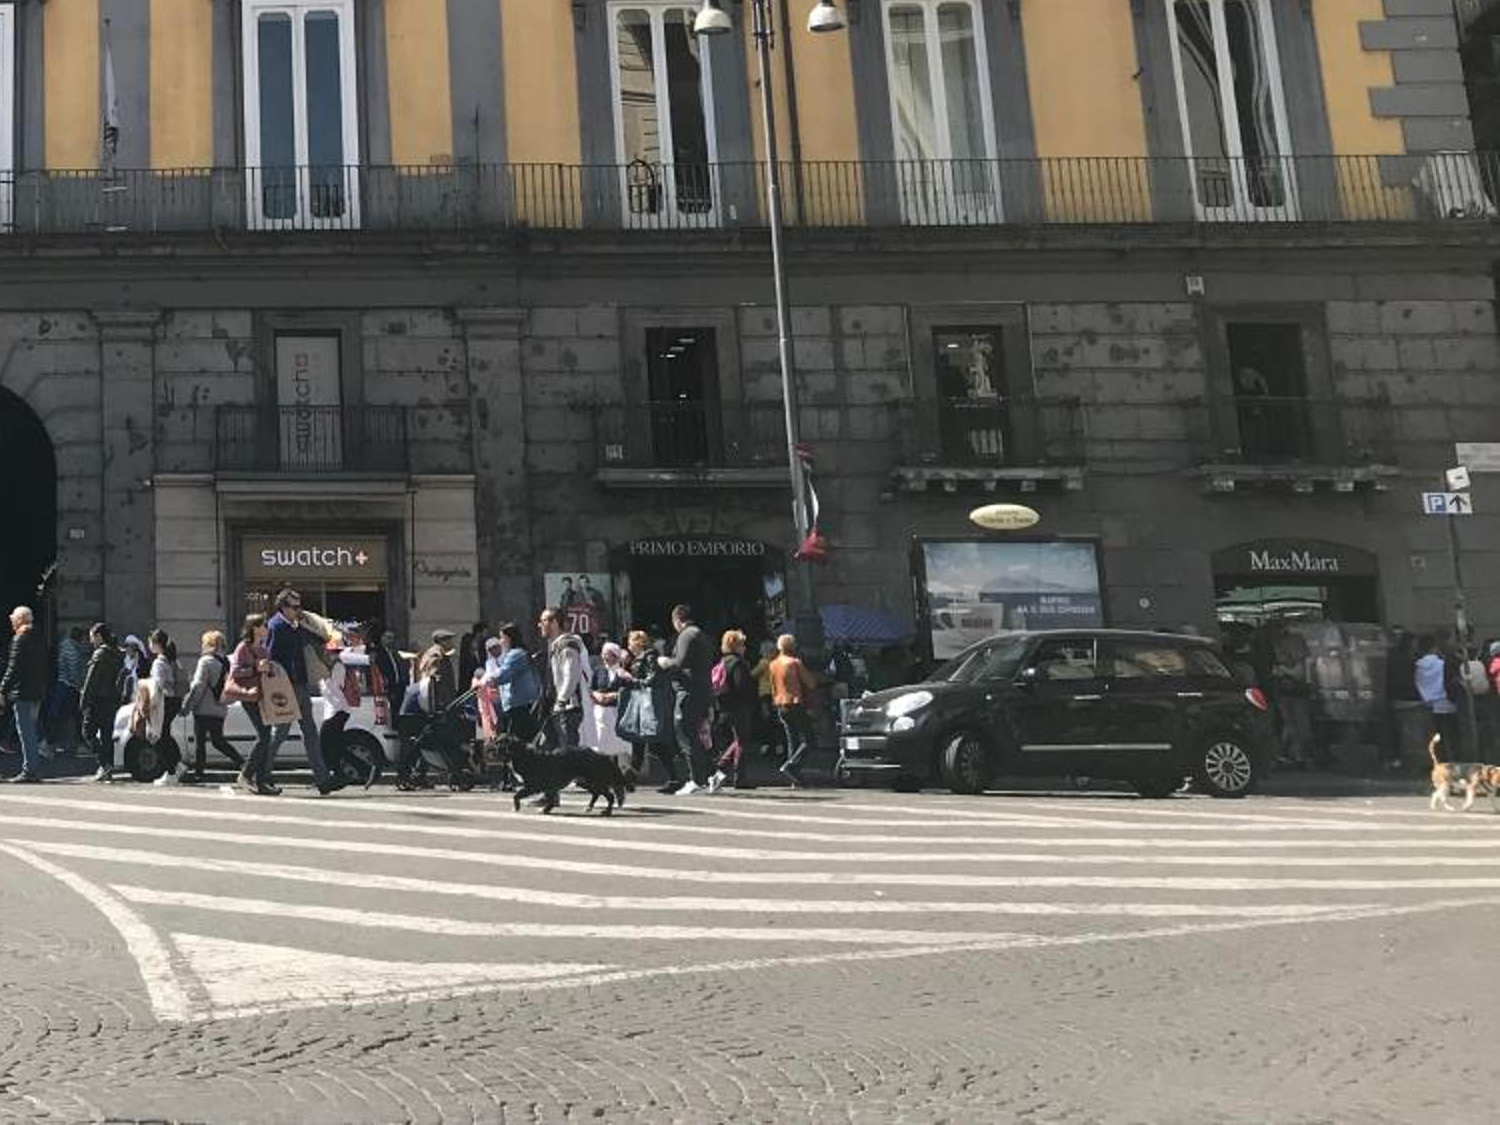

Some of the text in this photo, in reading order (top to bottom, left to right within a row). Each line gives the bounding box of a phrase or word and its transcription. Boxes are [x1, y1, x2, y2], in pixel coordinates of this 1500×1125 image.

[261, 546, 353, 567] swatch
[628, 539, 766, 556] PRIMO EMPORIO
[1248, 549, 1339, 572] MaxMara
[567, 612, 589, 633] 70
